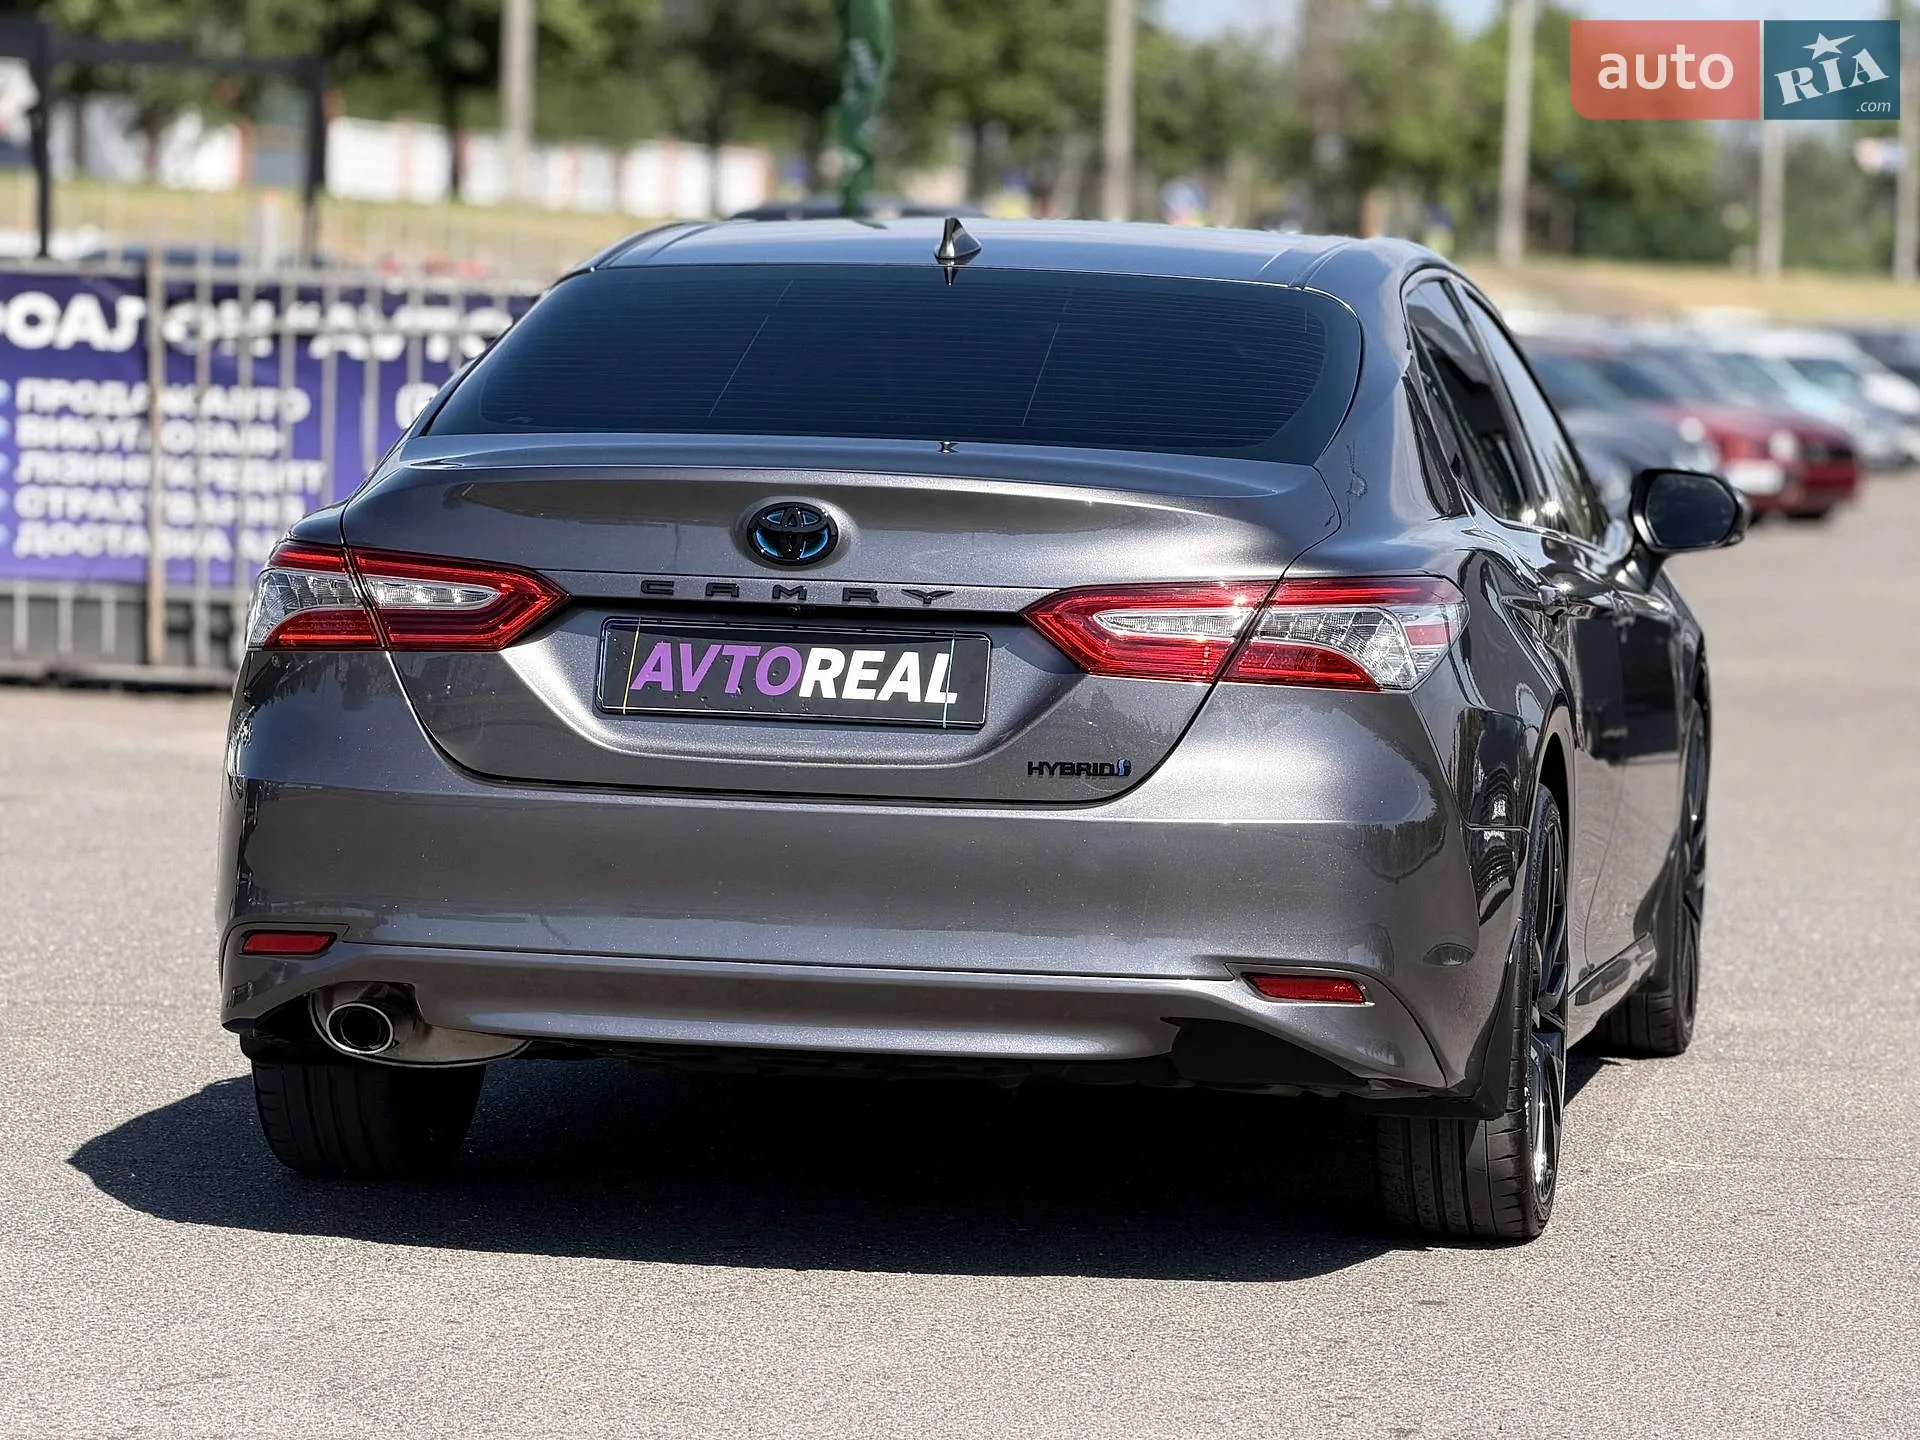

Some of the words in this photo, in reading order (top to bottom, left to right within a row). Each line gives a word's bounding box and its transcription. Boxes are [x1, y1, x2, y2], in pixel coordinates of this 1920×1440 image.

[640, 579, 956, 606] CAMRY
[629, 641, 960, 705] AVTOREAL
[1026, 760, 1117, 777] HYBRID
